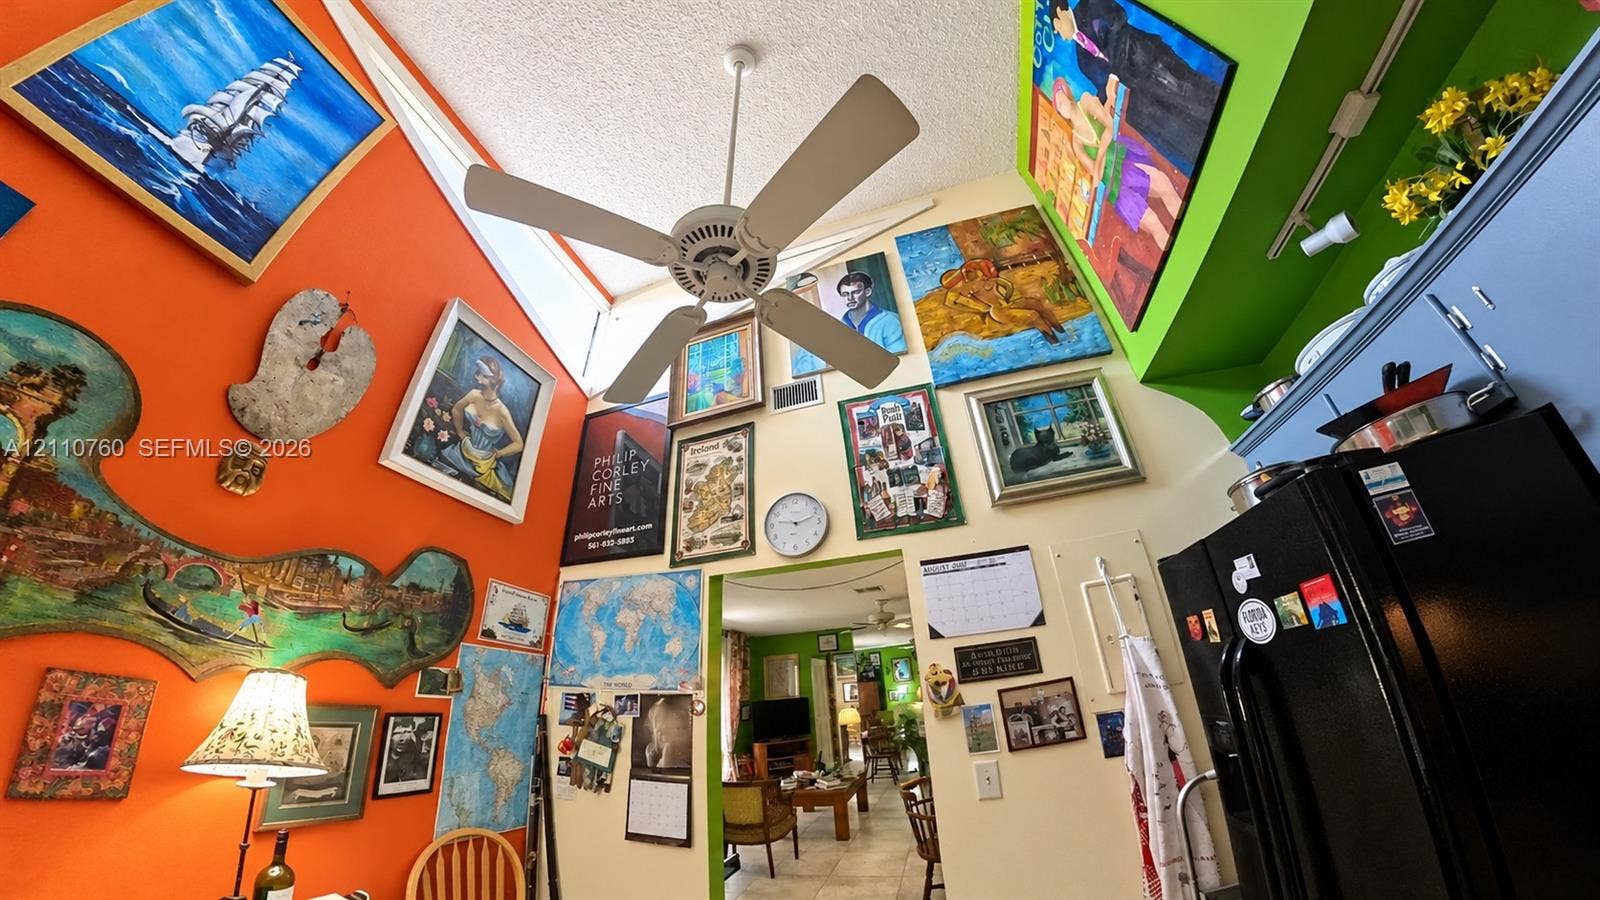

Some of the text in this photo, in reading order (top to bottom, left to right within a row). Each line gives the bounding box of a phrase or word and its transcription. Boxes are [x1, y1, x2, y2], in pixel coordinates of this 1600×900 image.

[690, 442, 720, 456] Ireland
[594, 449, 637, 469] PHILIP
[592, 459, 650, 481] CORLEY
[590, 478, 622, 496] FINE
[587, 492, 623, 509] ARTS
[573, 523, 653, 542] philipcorleyfineart.com
[1242, 607, 1267, 623] FLORIDA
[1250, 621, 1267, 635] KEYS
